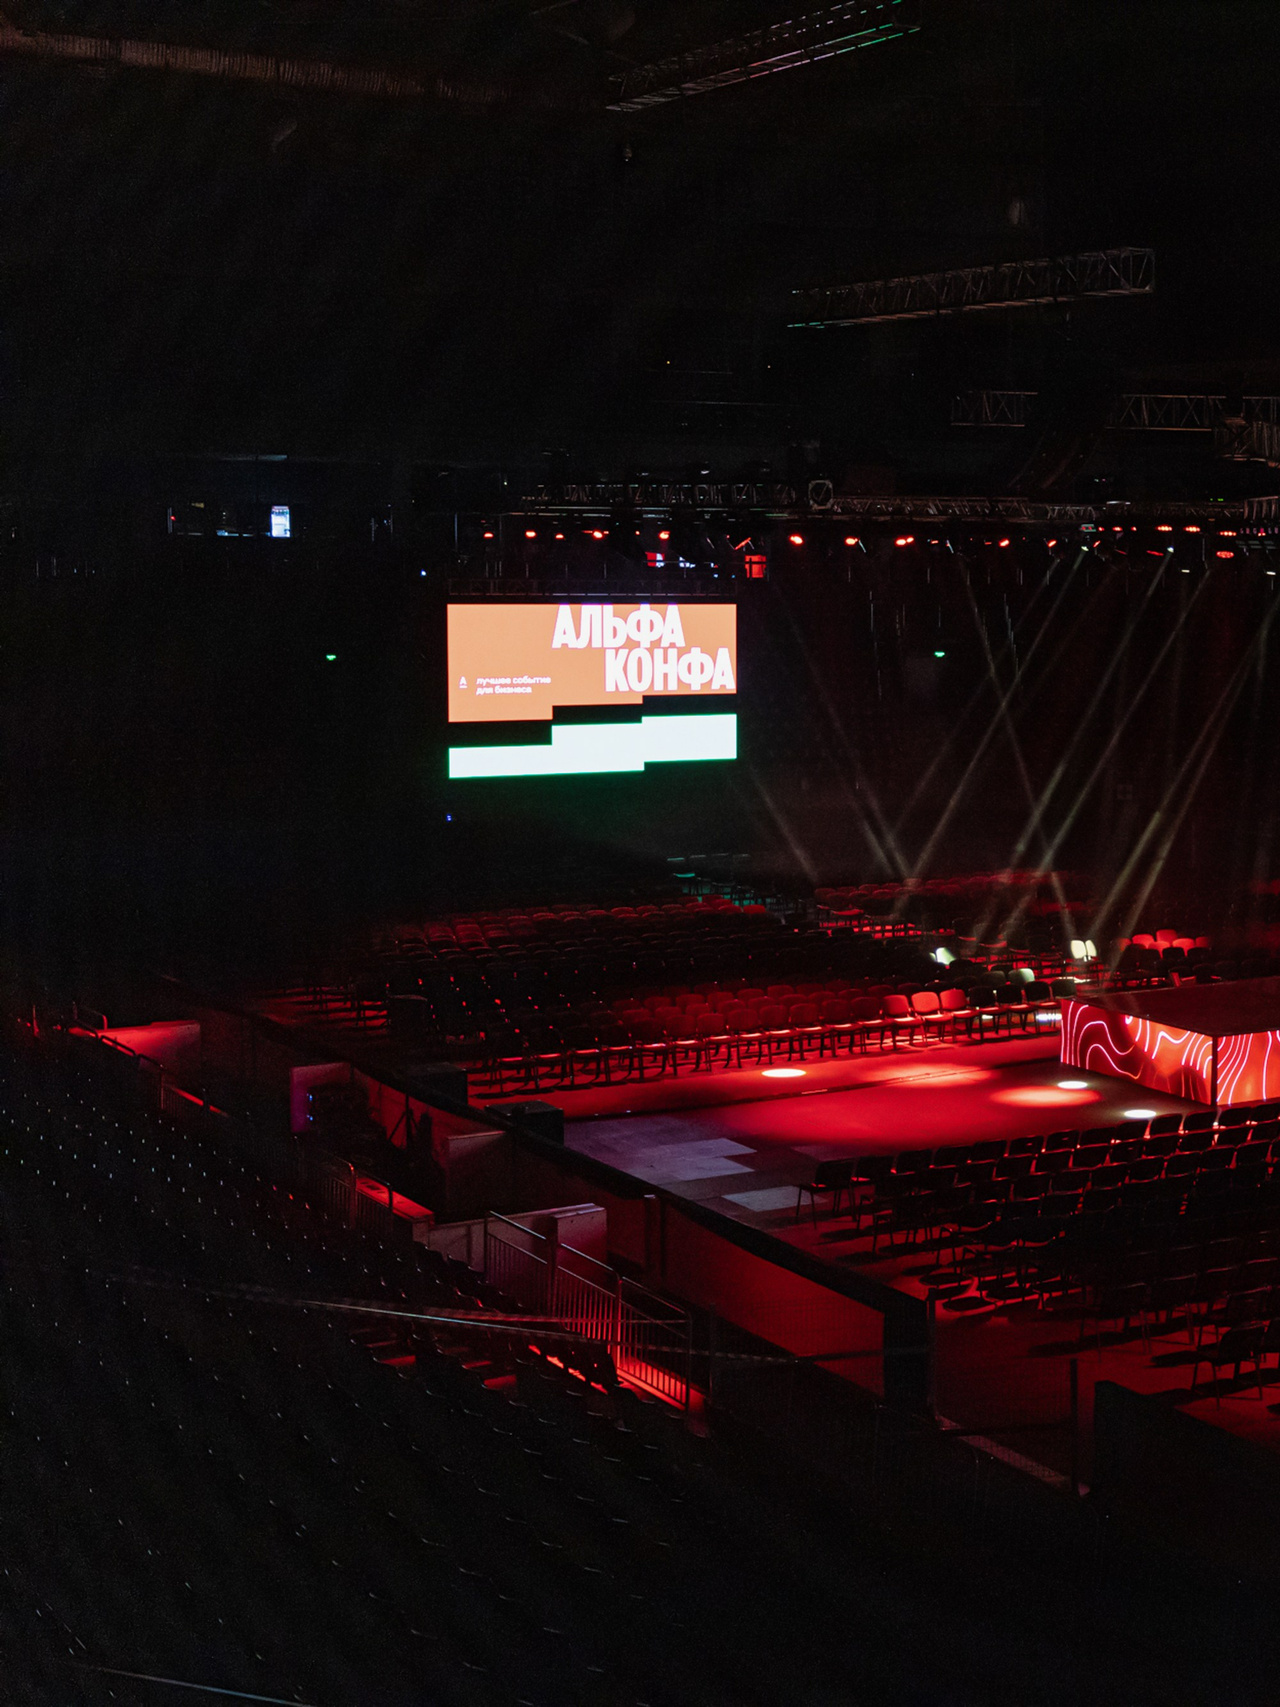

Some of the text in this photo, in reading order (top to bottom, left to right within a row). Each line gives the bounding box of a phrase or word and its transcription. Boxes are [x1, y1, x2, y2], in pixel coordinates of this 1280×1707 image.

[552, 603, 686, 649] АЛЬФА
[476, 675, 551, 686] лучшее событие
[605, 647, 736, 692] КОНФА
[476, 685, 532, 695] для бизнеса
